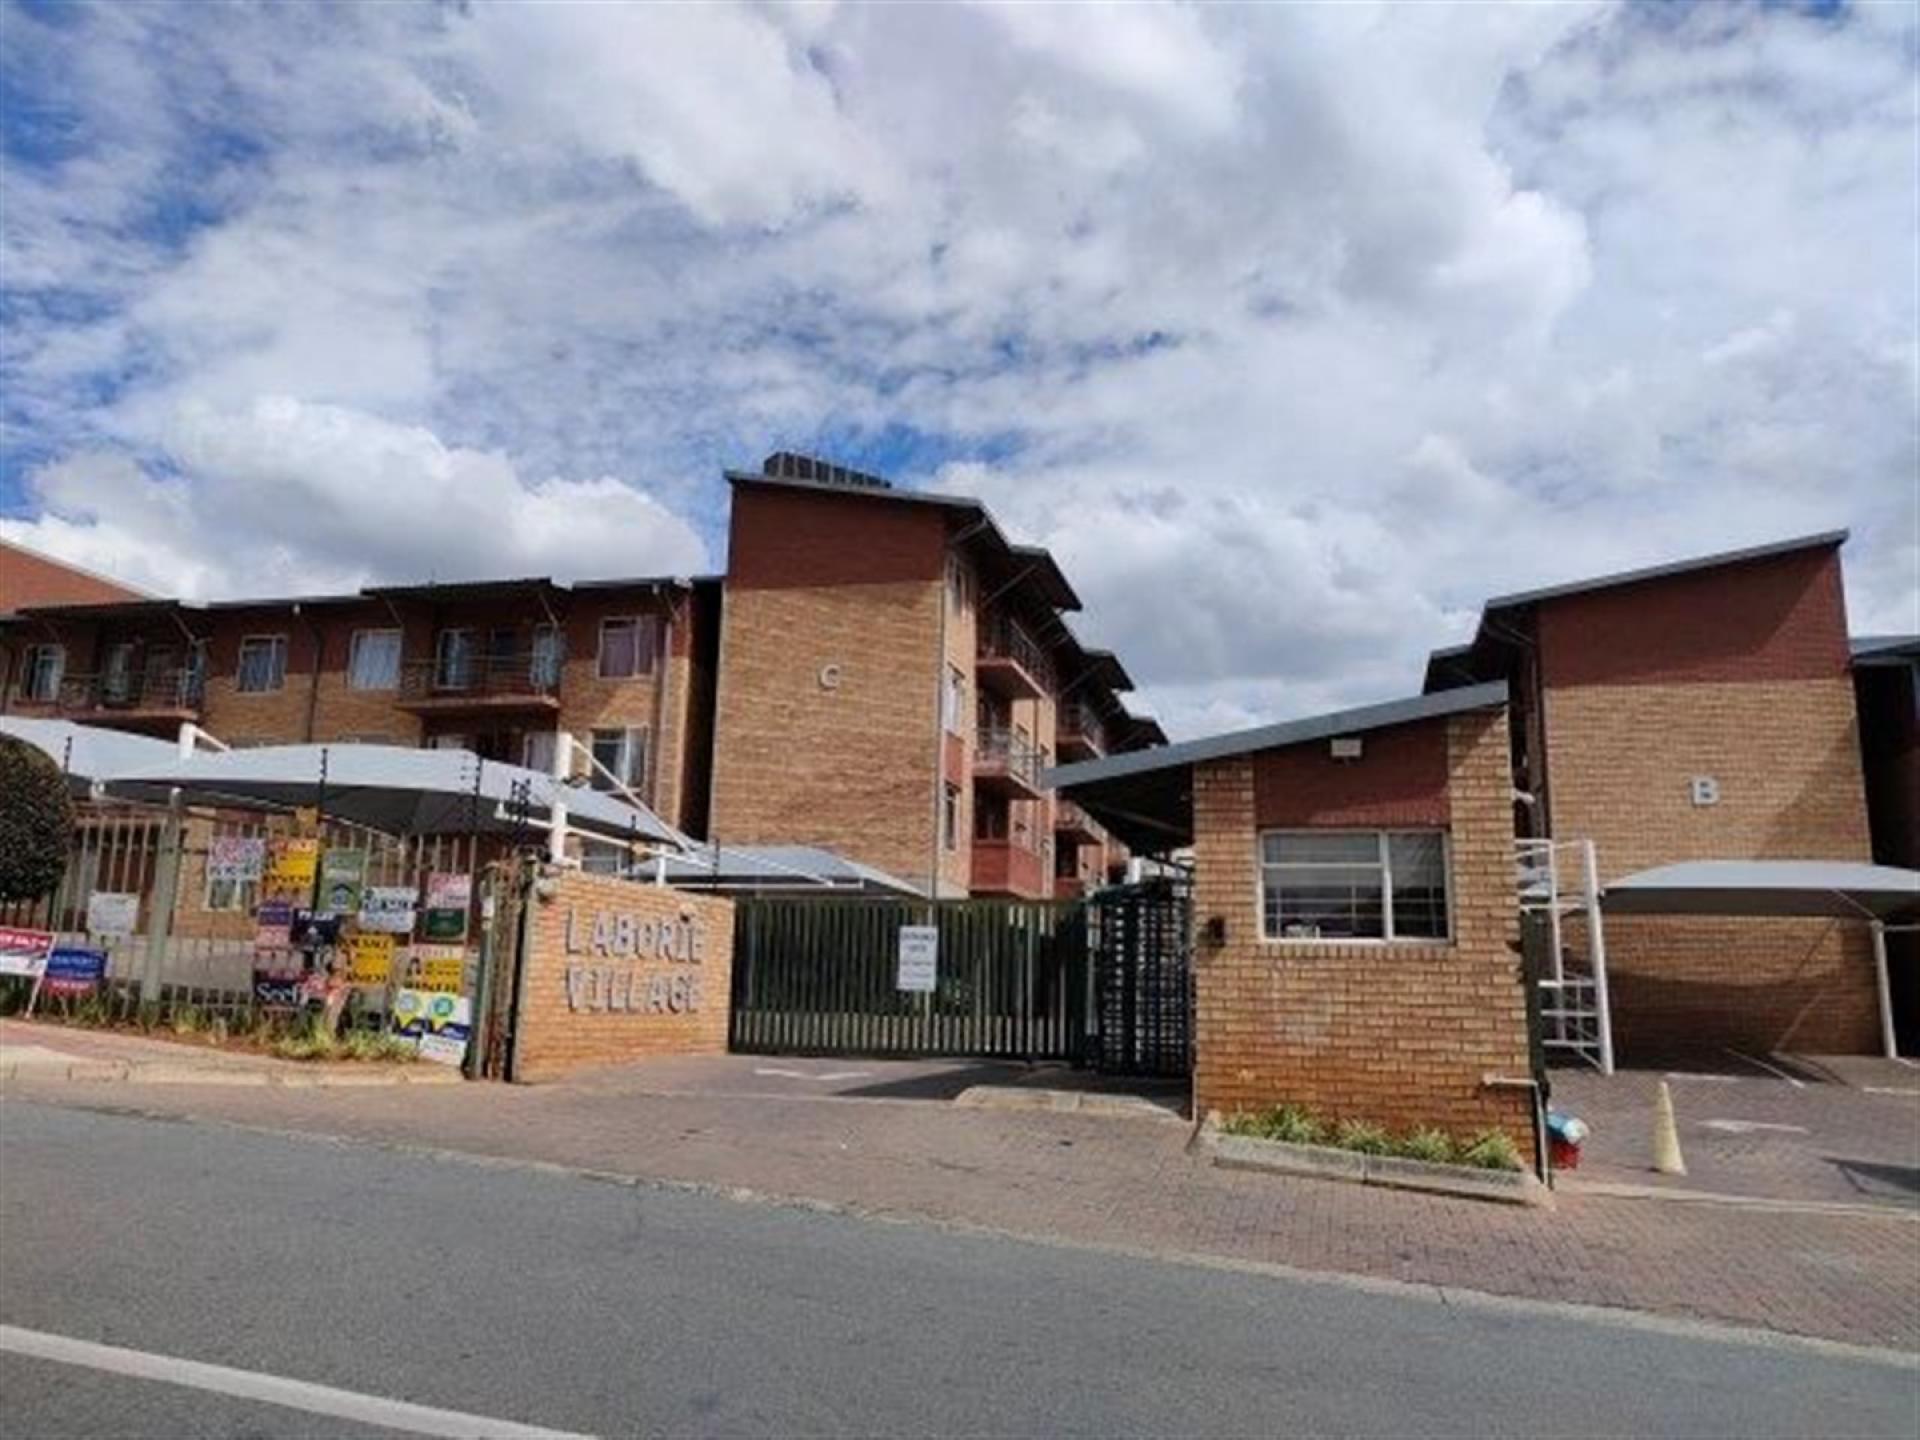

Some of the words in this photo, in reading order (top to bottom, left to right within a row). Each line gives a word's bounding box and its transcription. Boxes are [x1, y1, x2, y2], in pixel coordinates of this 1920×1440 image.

[820, 663, 841, 691] C
[1692, 774, 1720, 806] B
[566, 904, 702, 965] LABORIE
[565, 965, 699, 1014] VILLAGE
